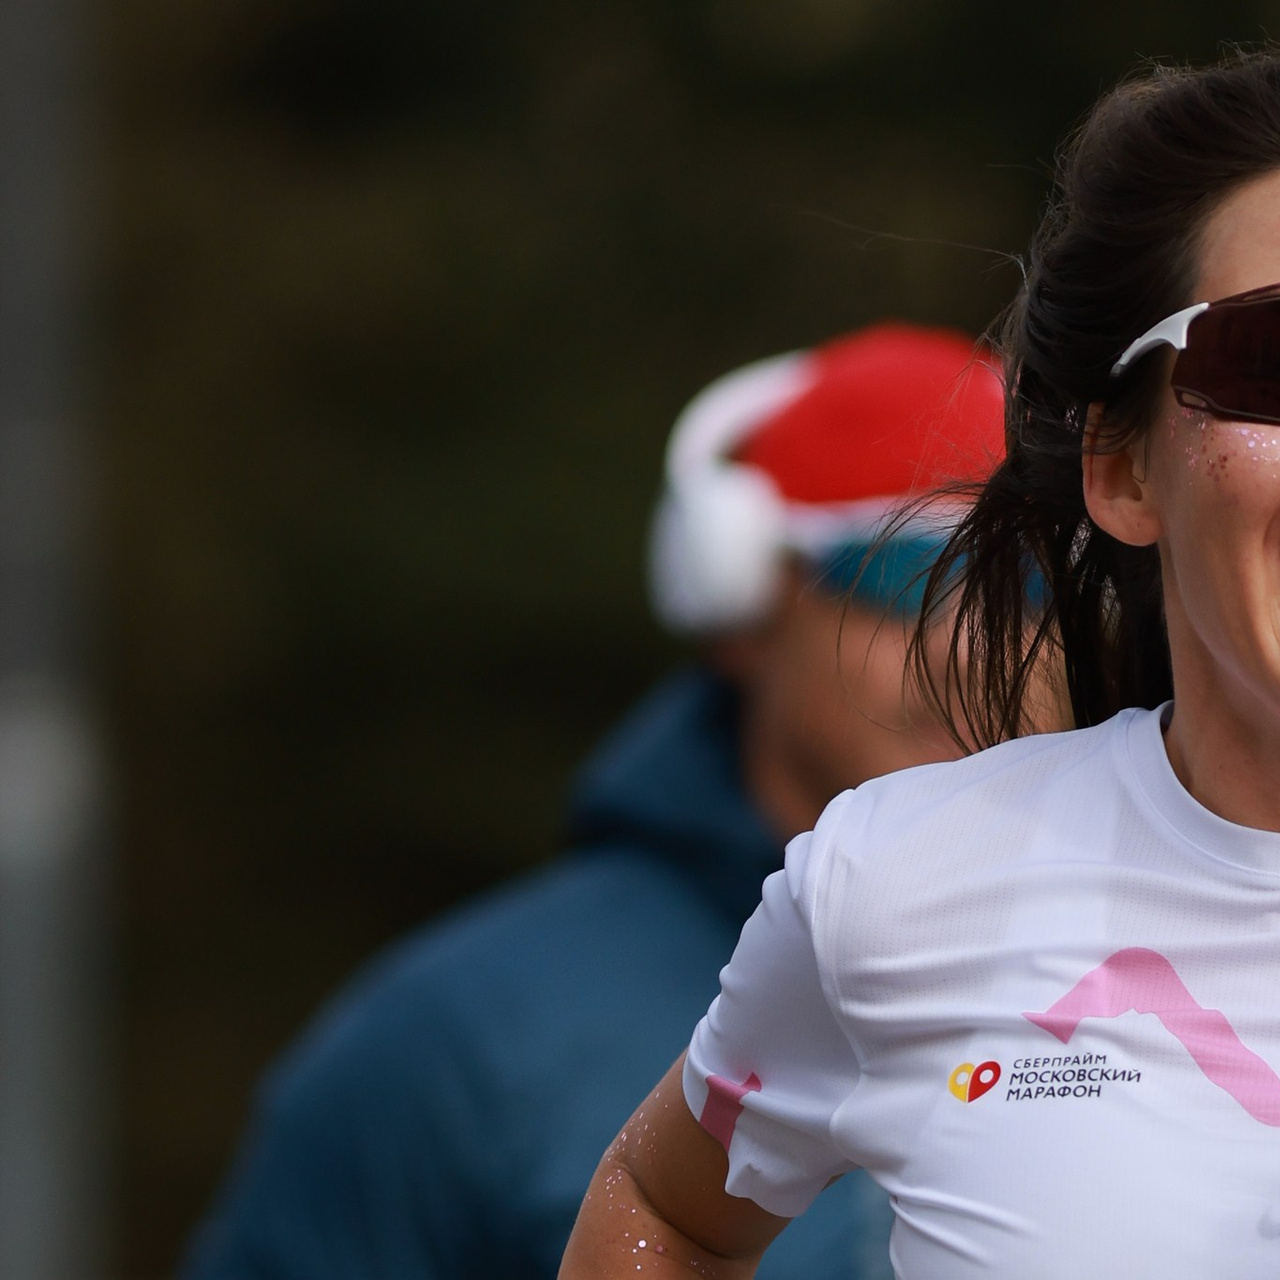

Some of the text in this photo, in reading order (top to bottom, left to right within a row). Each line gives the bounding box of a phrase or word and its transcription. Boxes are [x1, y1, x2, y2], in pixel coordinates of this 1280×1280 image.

[1013, 1052, 1107, 1069] СБЕРПРАЙМ
[1009, 1068, 1142, 1085] МОСКОВСКИЙ
[1006, 1084, 1101, 1101] МАРАФОН
